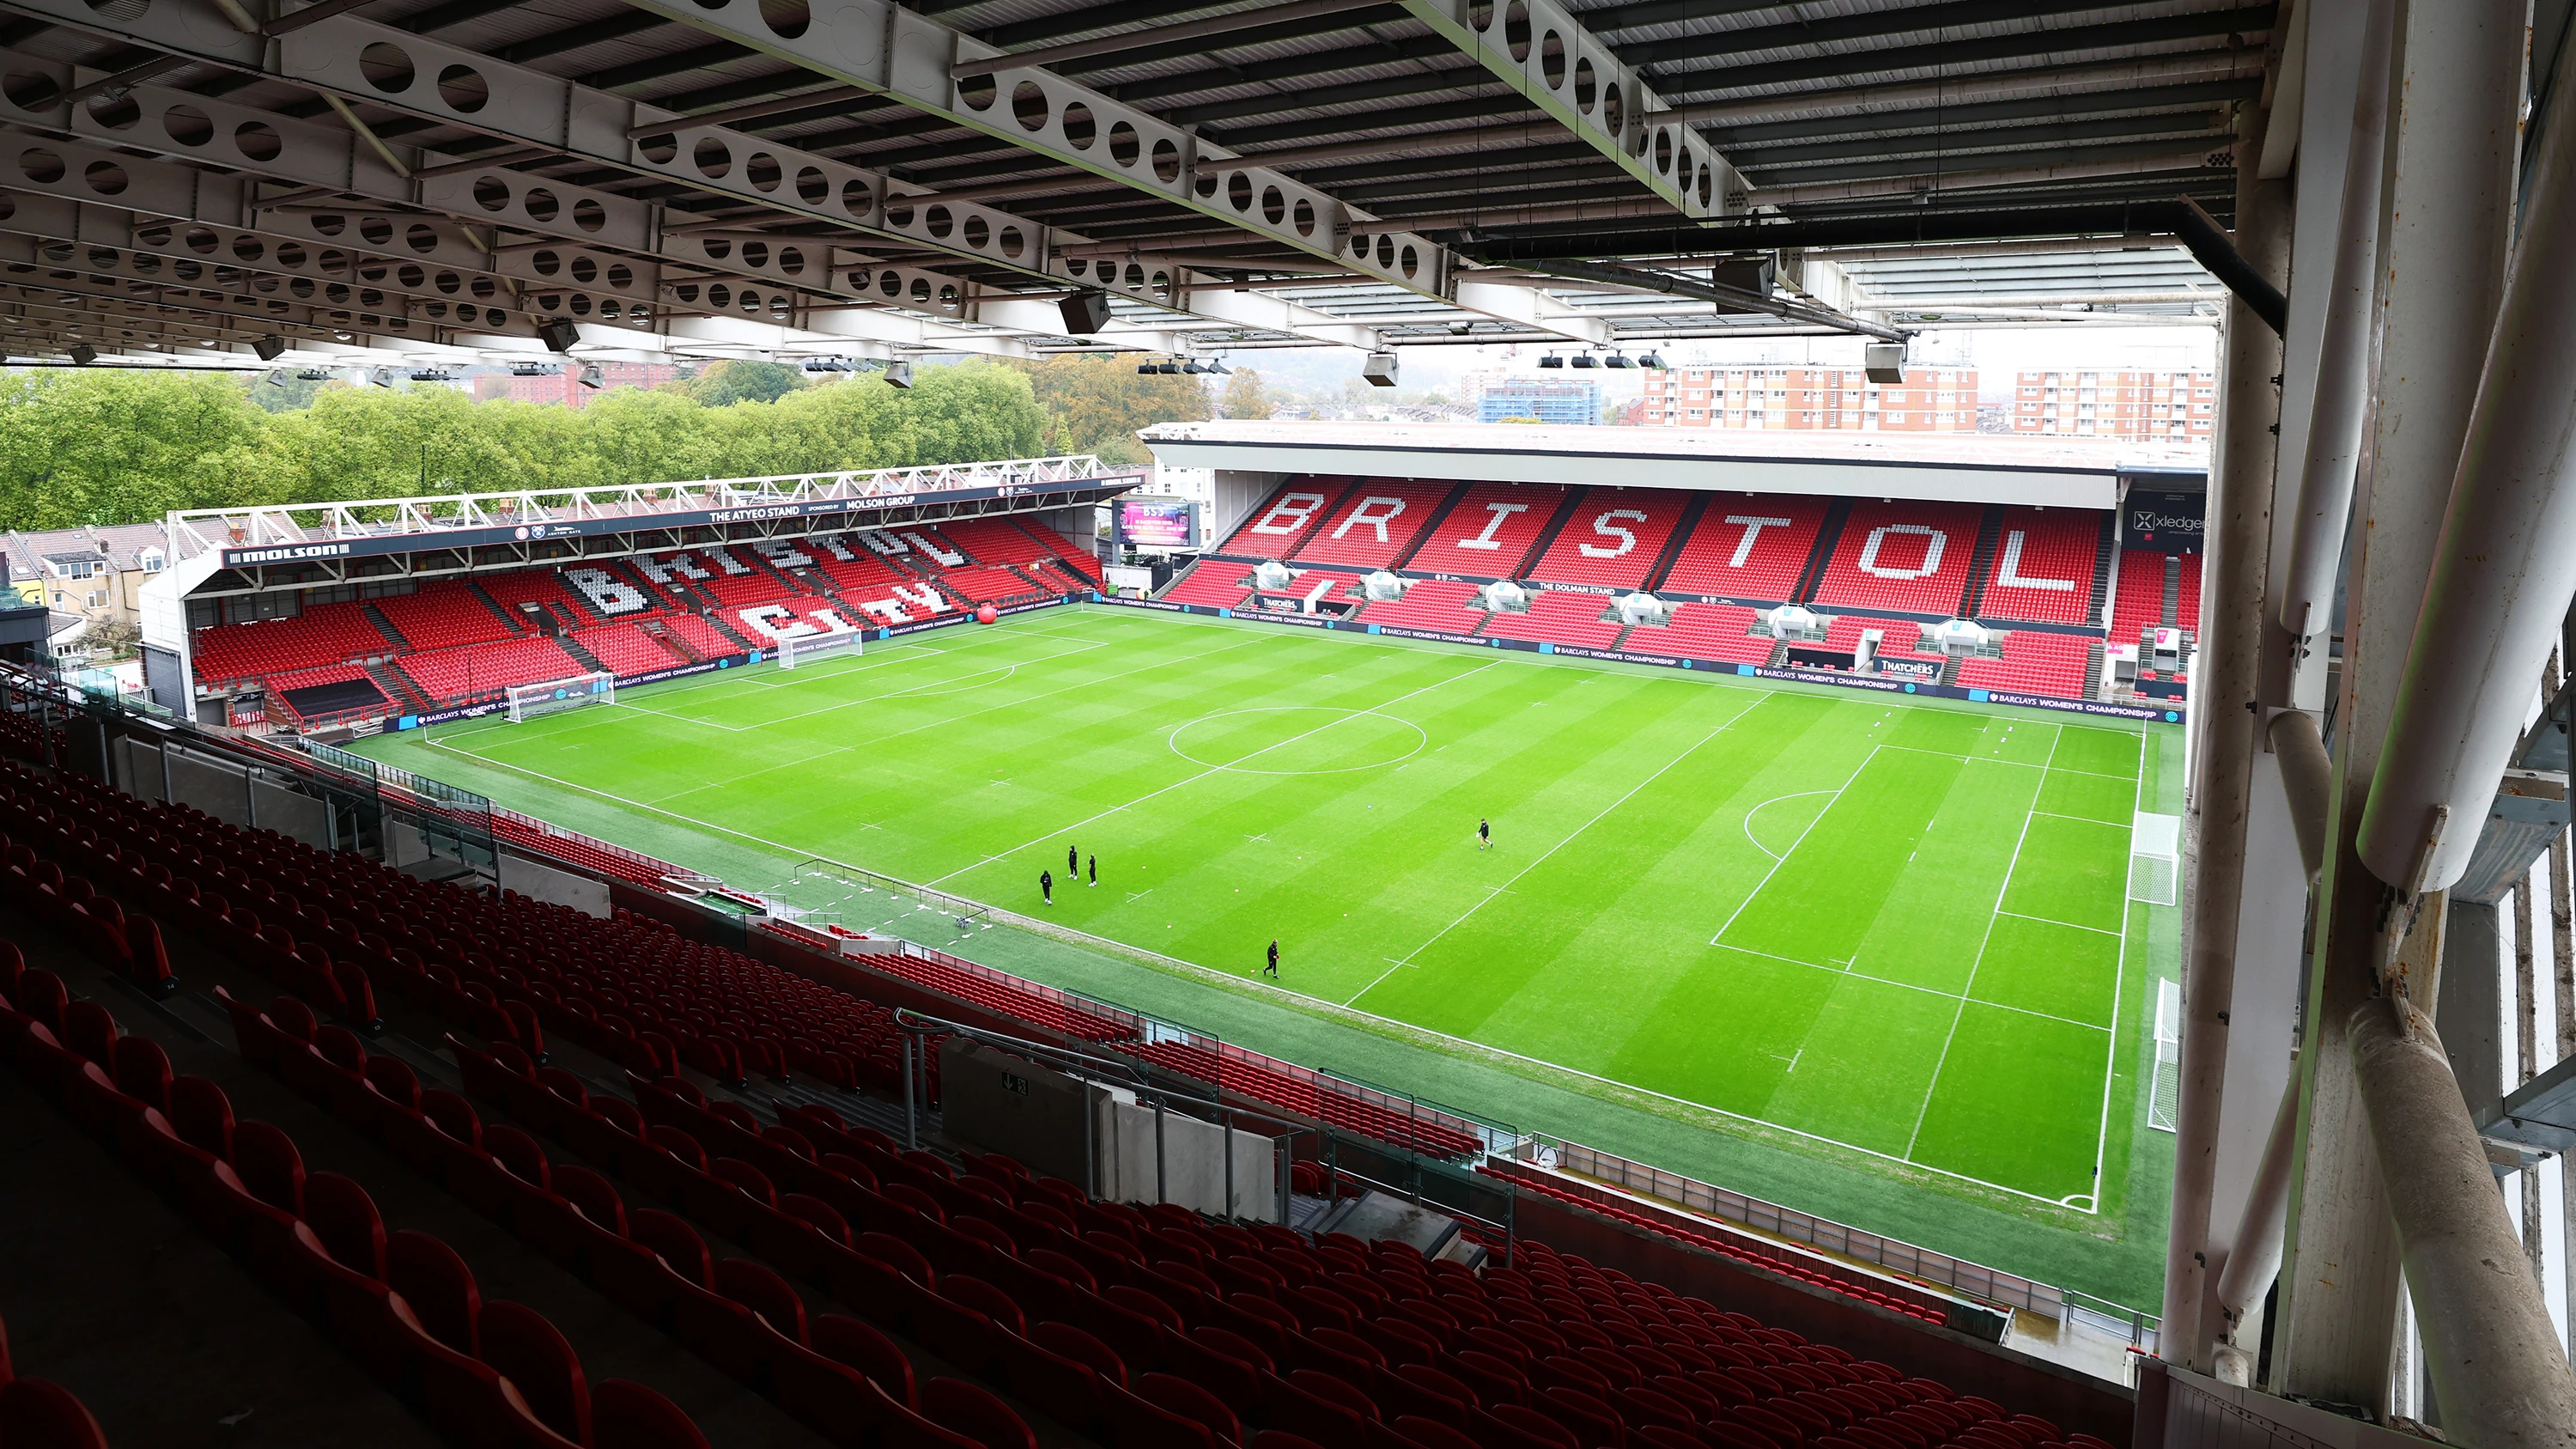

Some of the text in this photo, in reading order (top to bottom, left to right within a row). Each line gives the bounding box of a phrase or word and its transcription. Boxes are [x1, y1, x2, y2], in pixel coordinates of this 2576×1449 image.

[709, 511, 730, 522] THE
[732, 508, 767, 521] ATYEO
[768, 505, 800, 517] STAND
[847, 497, 885, 510] MOLSON
[886, 495, 915, 507] GROUP
[2155, 515, 2205, 531] xledger
[242, 545, 338, 563] MOLSON
[1555, 584, 1589, 593] DOLMAN
[1284, 618, 1322, 627] CHAMPIONSHIP
[1387, 628, 1486, 644] BARCLAYS WOMEN'S CHAMPIONSHIP
[1561, 648, 1676, 666] BARCLAYS WOMEN'S CHAMPIONSHIP
[615, 663, 715, 687] BARCLAYS WOMEN'S CHAMPIONSHIP
[1881, 660, 1934, 675] THATCHERS
[1763, 670, 1898, 690] BARCLAYS WOMEN'S CHAMPIONSHIP
[426, 710, 459, 722] BARCLAYS
[461, 703, 496, 715] WOMEN'S
[1999, 695, 2157, 718] BARCLAYS WOMEN'S CHAMPIONSHIP
